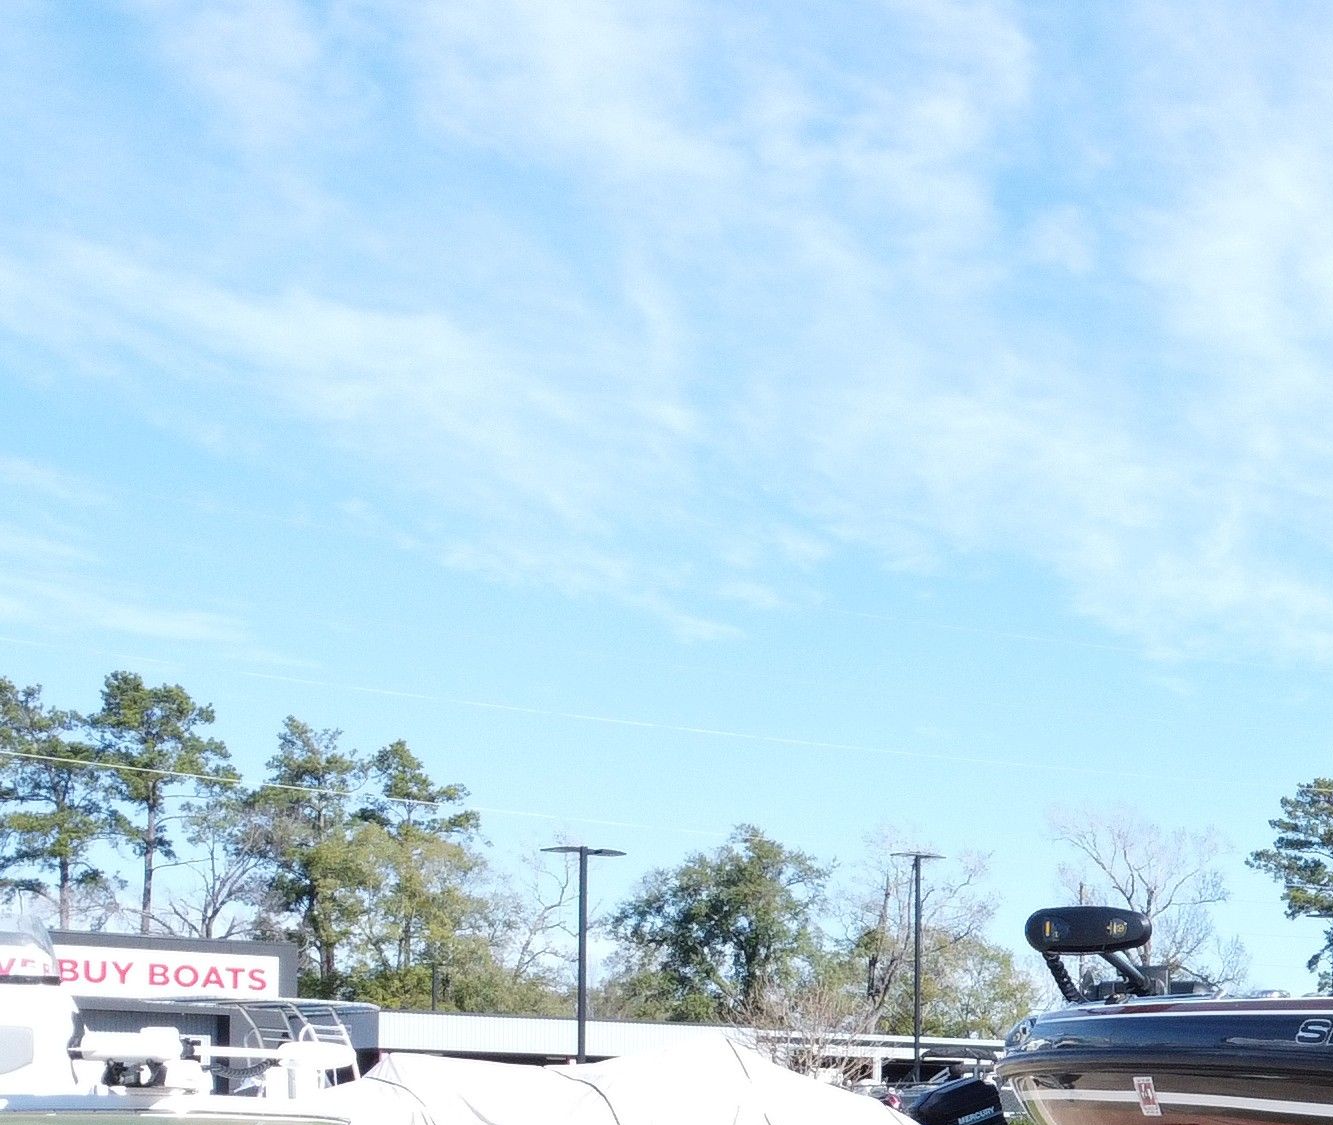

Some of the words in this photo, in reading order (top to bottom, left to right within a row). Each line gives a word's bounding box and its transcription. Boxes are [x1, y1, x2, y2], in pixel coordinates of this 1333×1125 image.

[57, 959, 134, 985] BUY
[148, 963, 268, 991] BOATS
[957, 1106, 995, 1125] MERCURY
